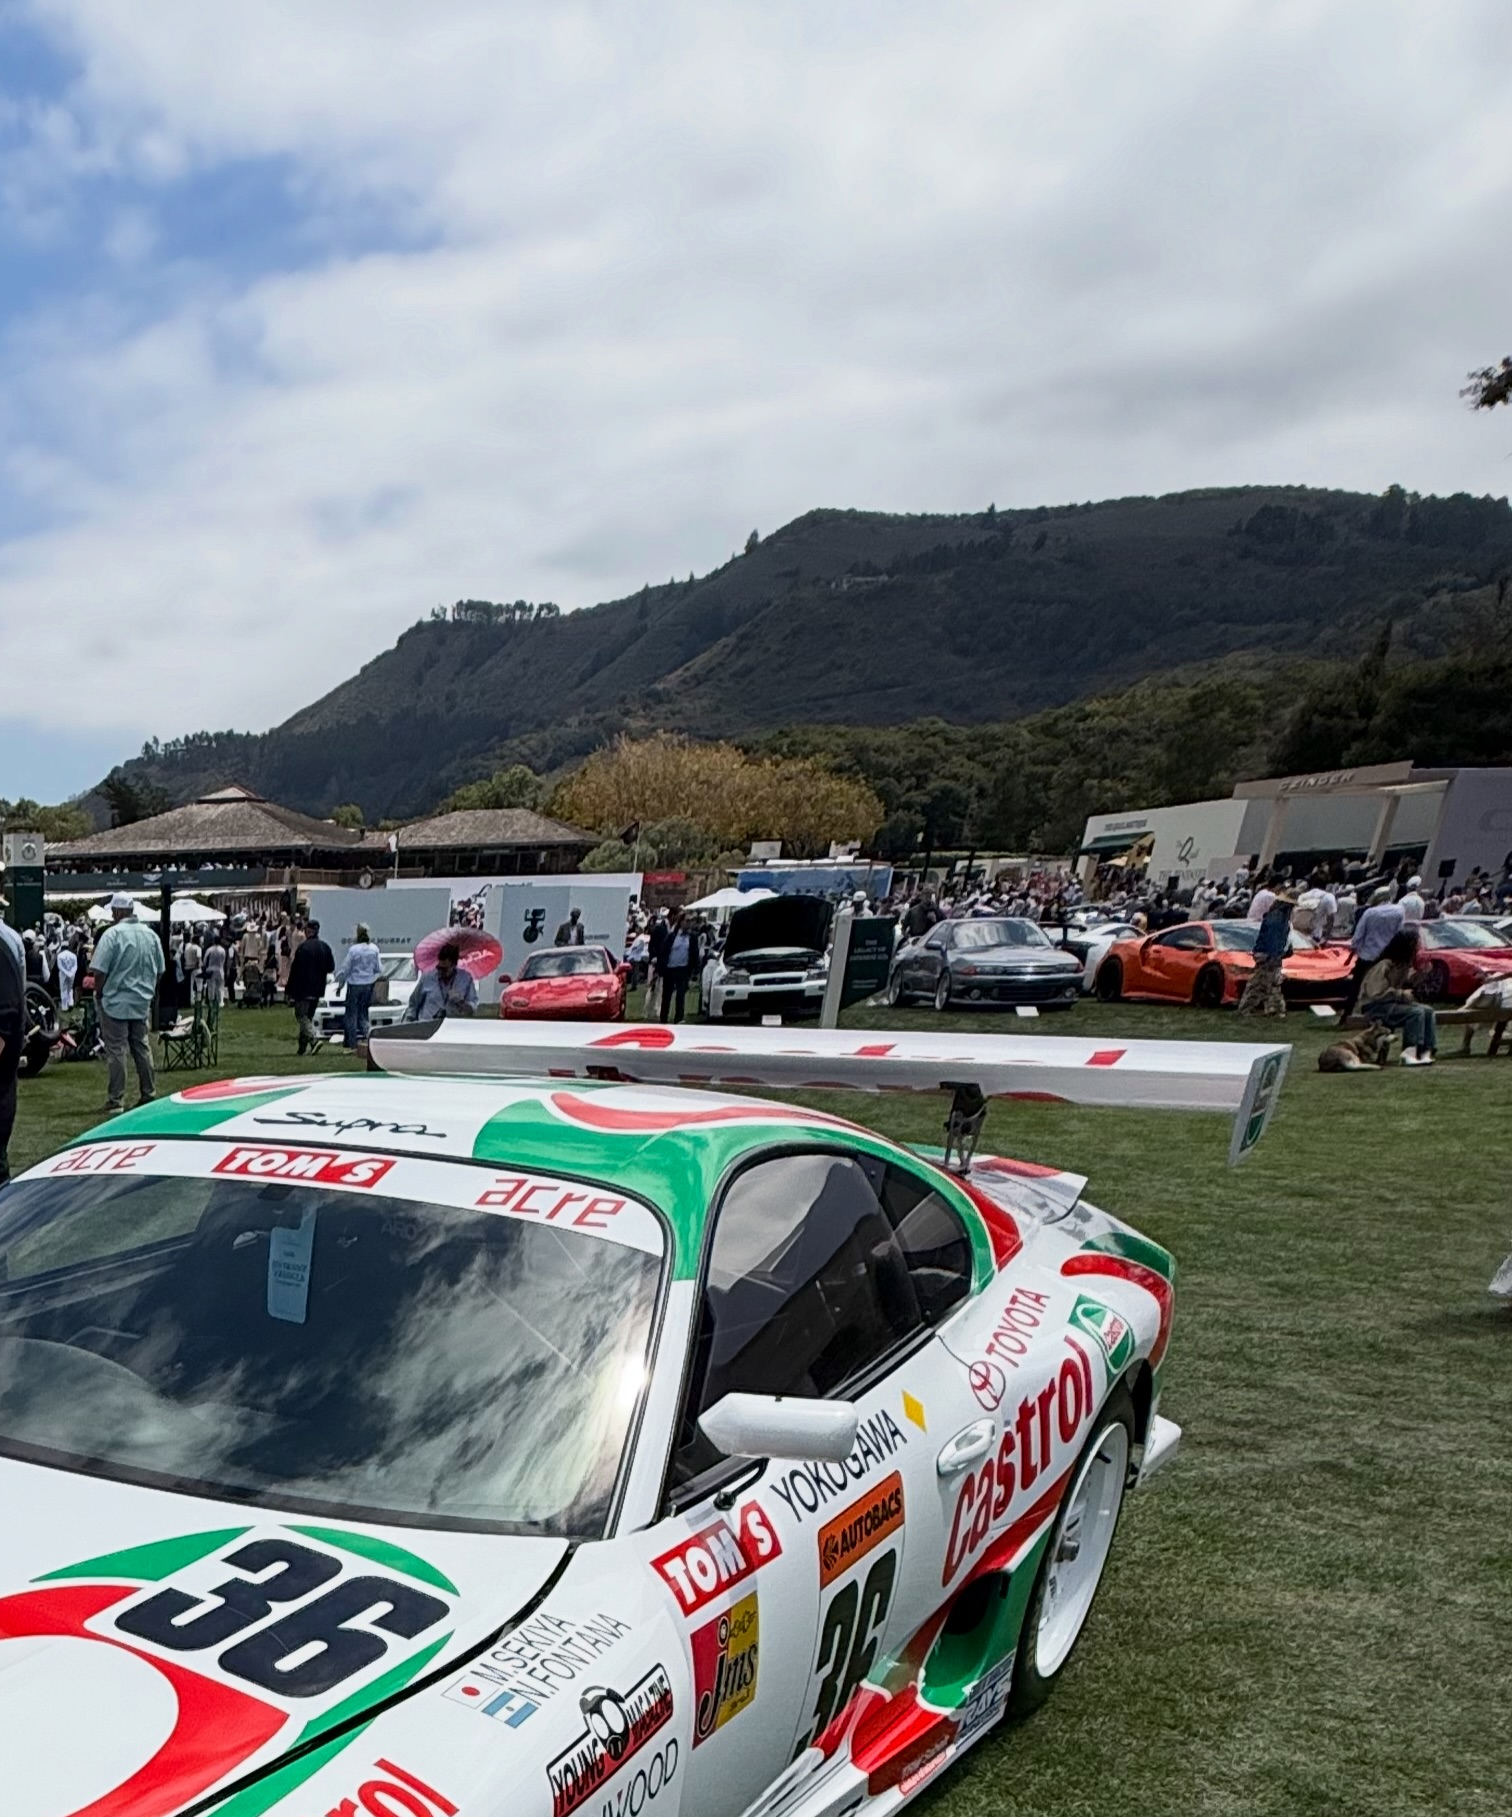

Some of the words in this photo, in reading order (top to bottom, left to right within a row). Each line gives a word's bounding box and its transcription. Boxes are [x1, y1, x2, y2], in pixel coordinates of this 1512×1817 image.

[254, 1111, 448, 1138] Supra
[50, 1144, 157, 1173] acre
[475, 1178, 628, 1228] acre
[985, 1287, 1051, 1368] TOYOTA
[769, 1409, 908, 1523] YOKOGAWA
[941, 1335, 1094, 1589] Castrol
[839, 1486, 902, 1558] AUTOBACS
[114, 1537, 451, 1699] 36
[791, 1547, 897, 1765] 36
[553, 1737, 606, 1815] YOUNG
